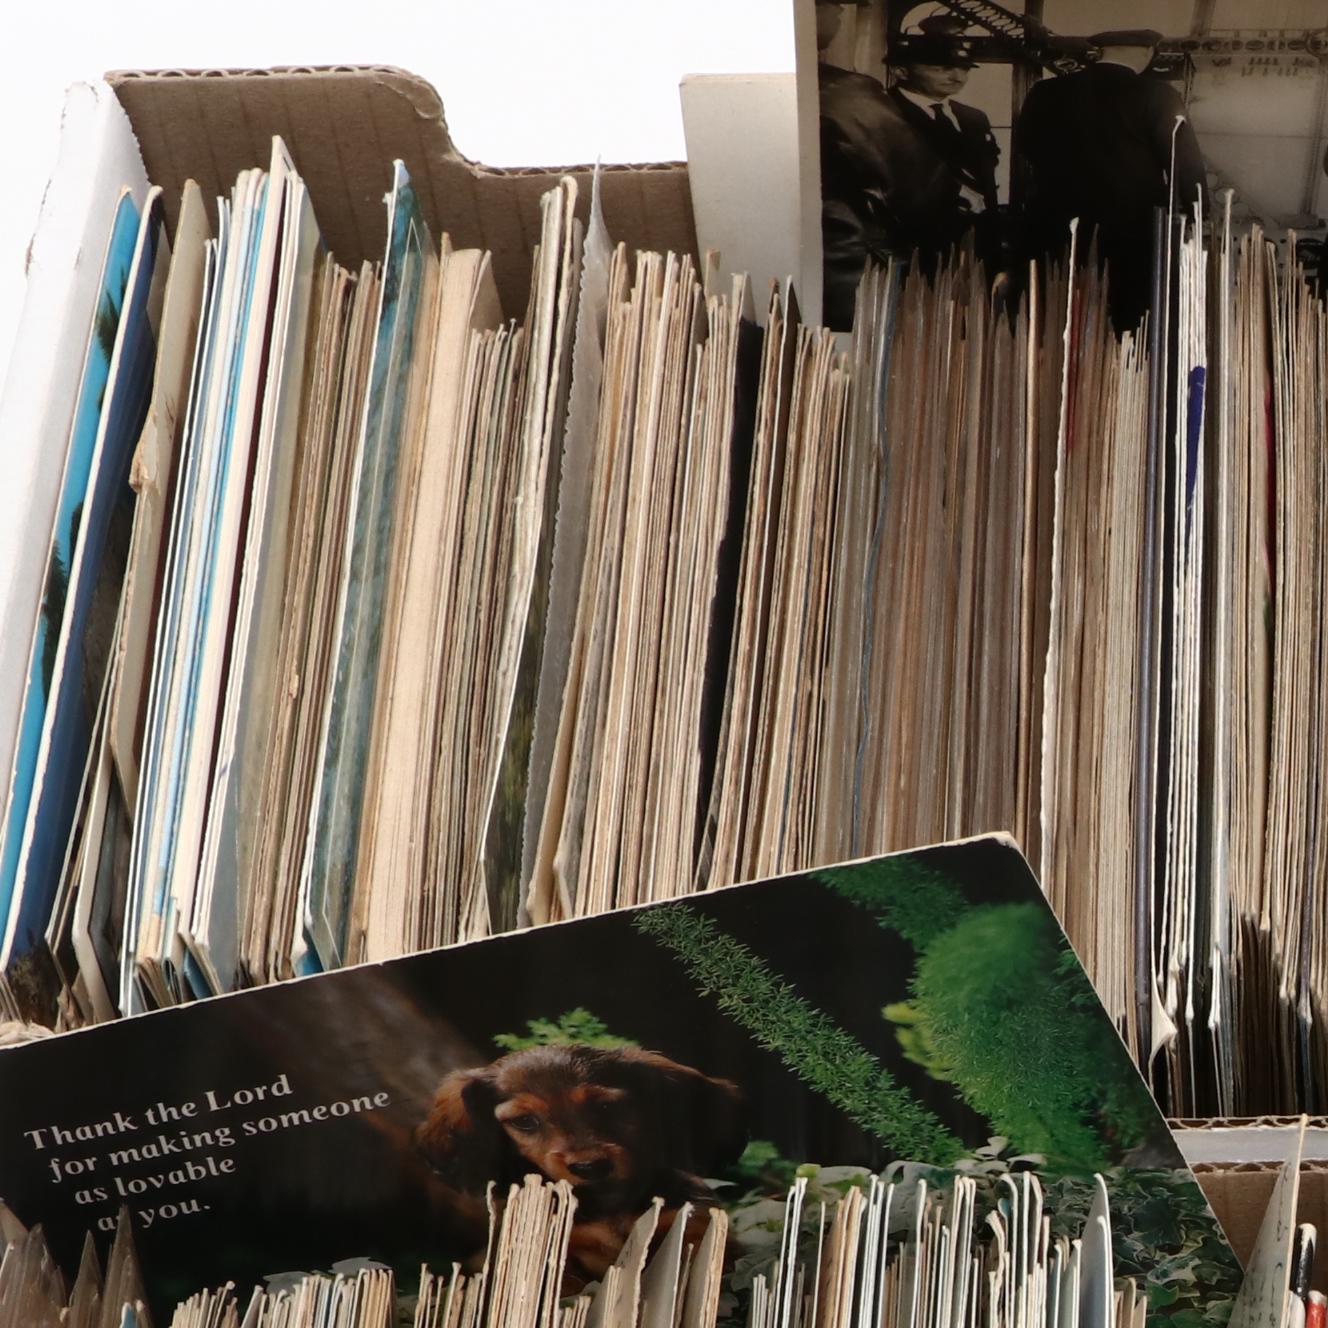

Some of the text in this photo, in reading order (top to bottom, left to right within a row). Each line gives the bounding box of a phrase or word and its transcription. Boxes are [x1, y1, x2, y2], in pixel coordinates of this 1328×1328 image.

[23, 1072, 294, 1151] Thank the Lord
[47, 1090, 393, 1184] for making someone
[73, 1153, 238, 1206] as lovable
[137, 1198, 211, 1229] you.
